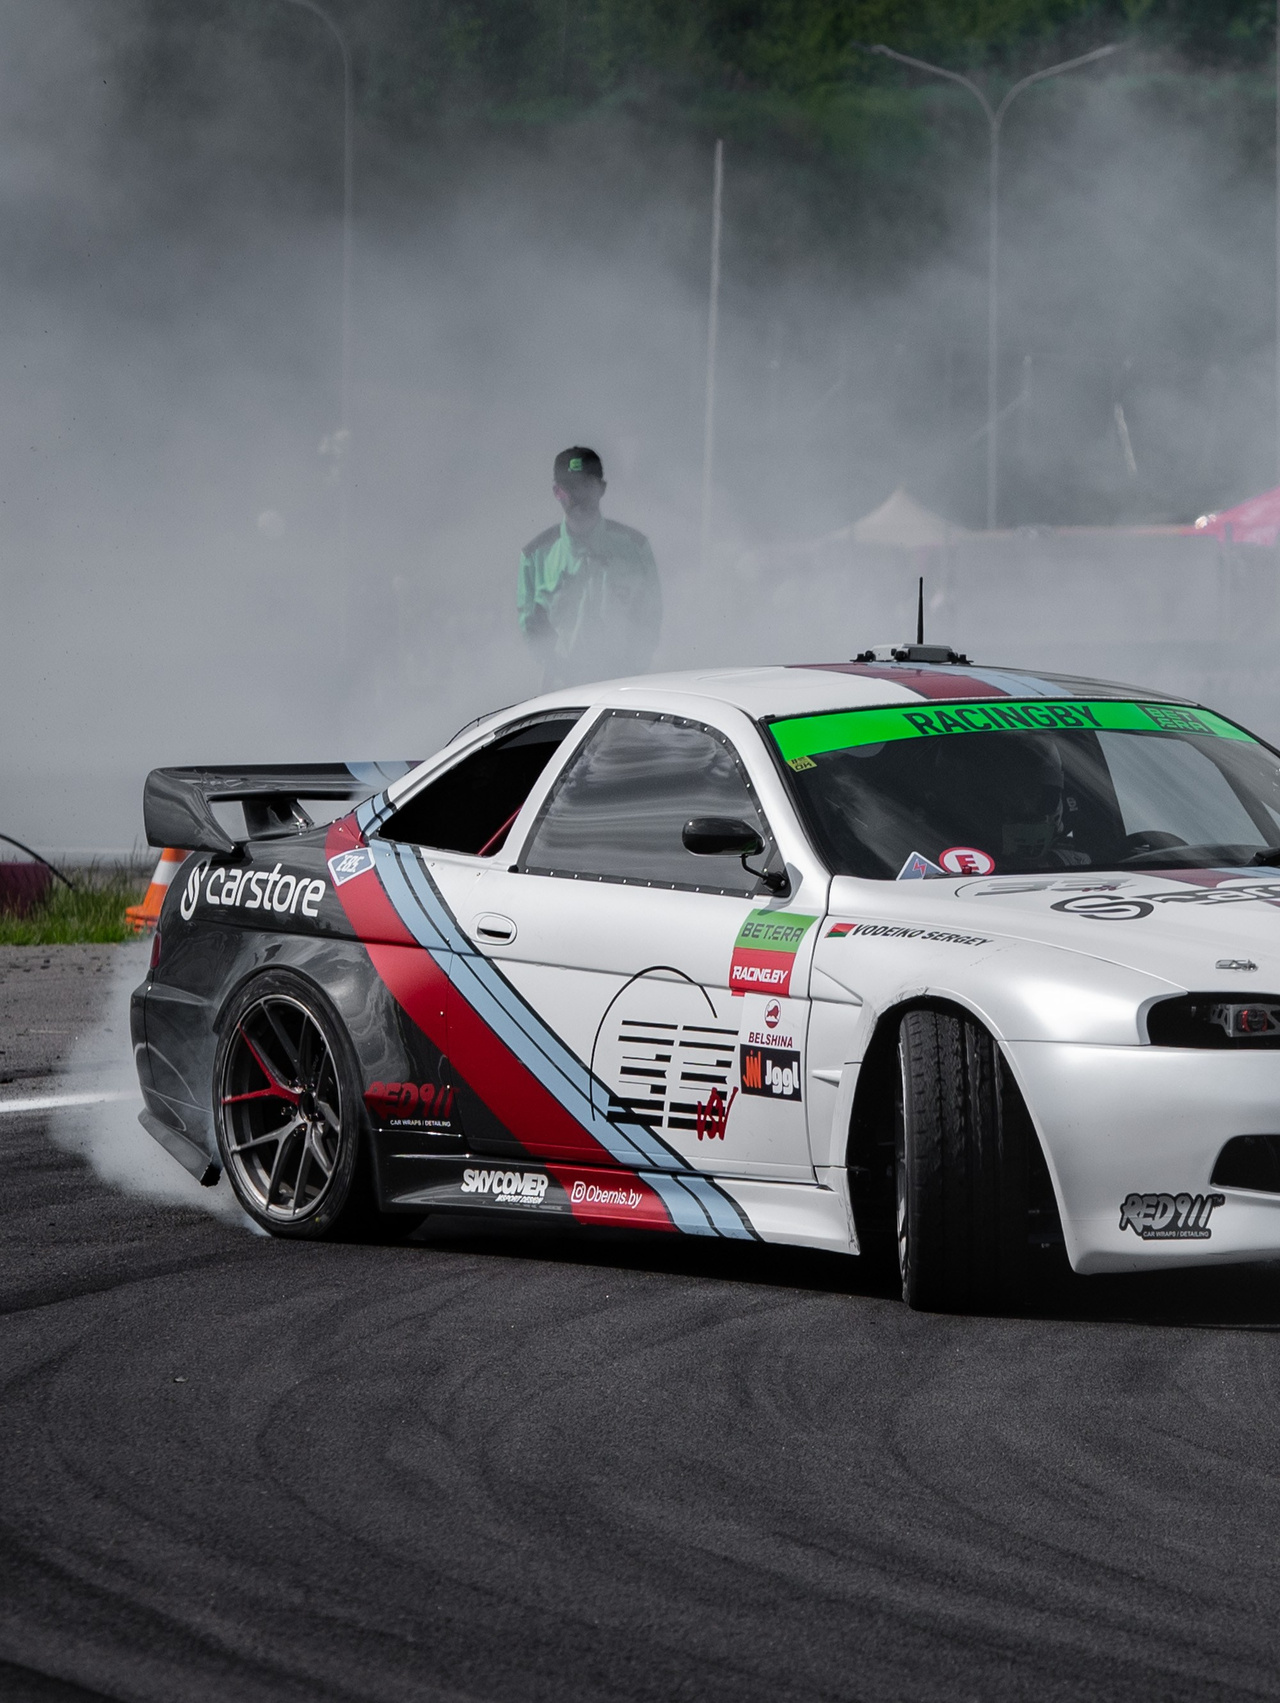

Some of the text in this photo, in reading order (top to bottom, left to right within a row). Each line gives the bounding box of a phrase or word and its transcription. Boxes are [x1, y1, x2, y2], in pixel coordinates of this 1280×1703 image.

[902, 704, 1102, 735] RACINGBY
[206, 863, 326, 917] carstore
[741, 922, 804, 943] BET.ERA
[852, 924, 993, 946] VODEIKO SERGEY
[748, 1031, 793, 1048] BELSHINA
